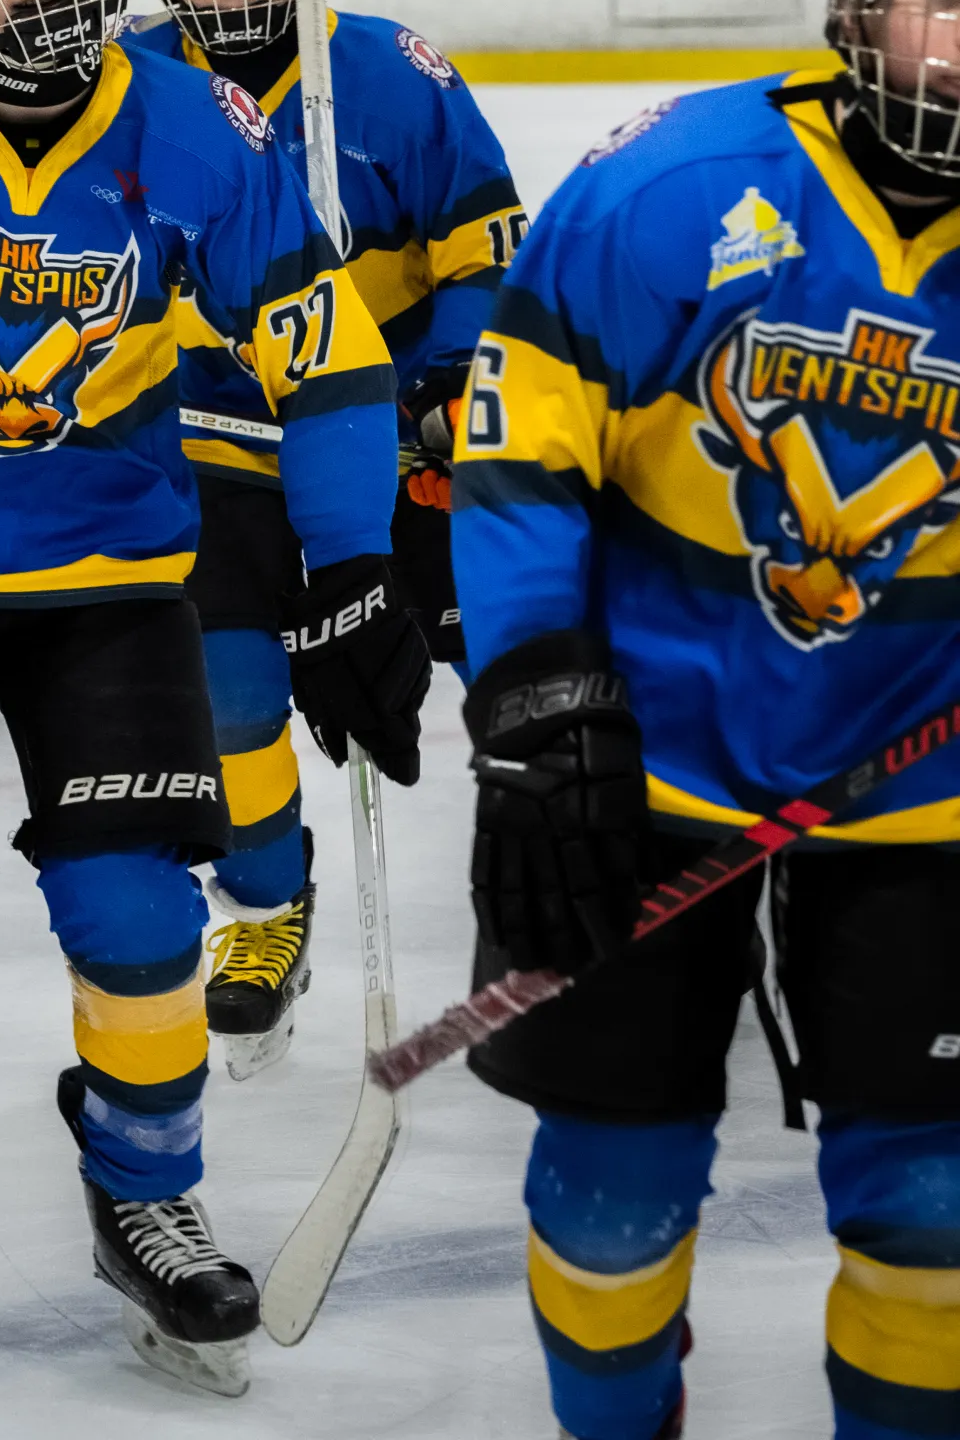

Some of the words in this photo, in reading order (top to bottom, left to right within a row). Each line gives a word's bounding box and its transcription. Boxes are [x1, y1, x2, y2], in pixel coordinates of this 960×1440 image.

[34, 18, 91, 47] CCM
[213, 25, 263, 40] CCM
[1, 238, 41, 271] HK
[267, 277, 336, 384] 27
[851, 324, 914, 373] HK
[750, 345, 960, 441] VENTSPIL
[180, 413, 264, 436] HYP2R
[280, 584, 387, 653] AUER
[486, 672, 630, 740] BAU
[58, 772, 218, 806] BAUER
